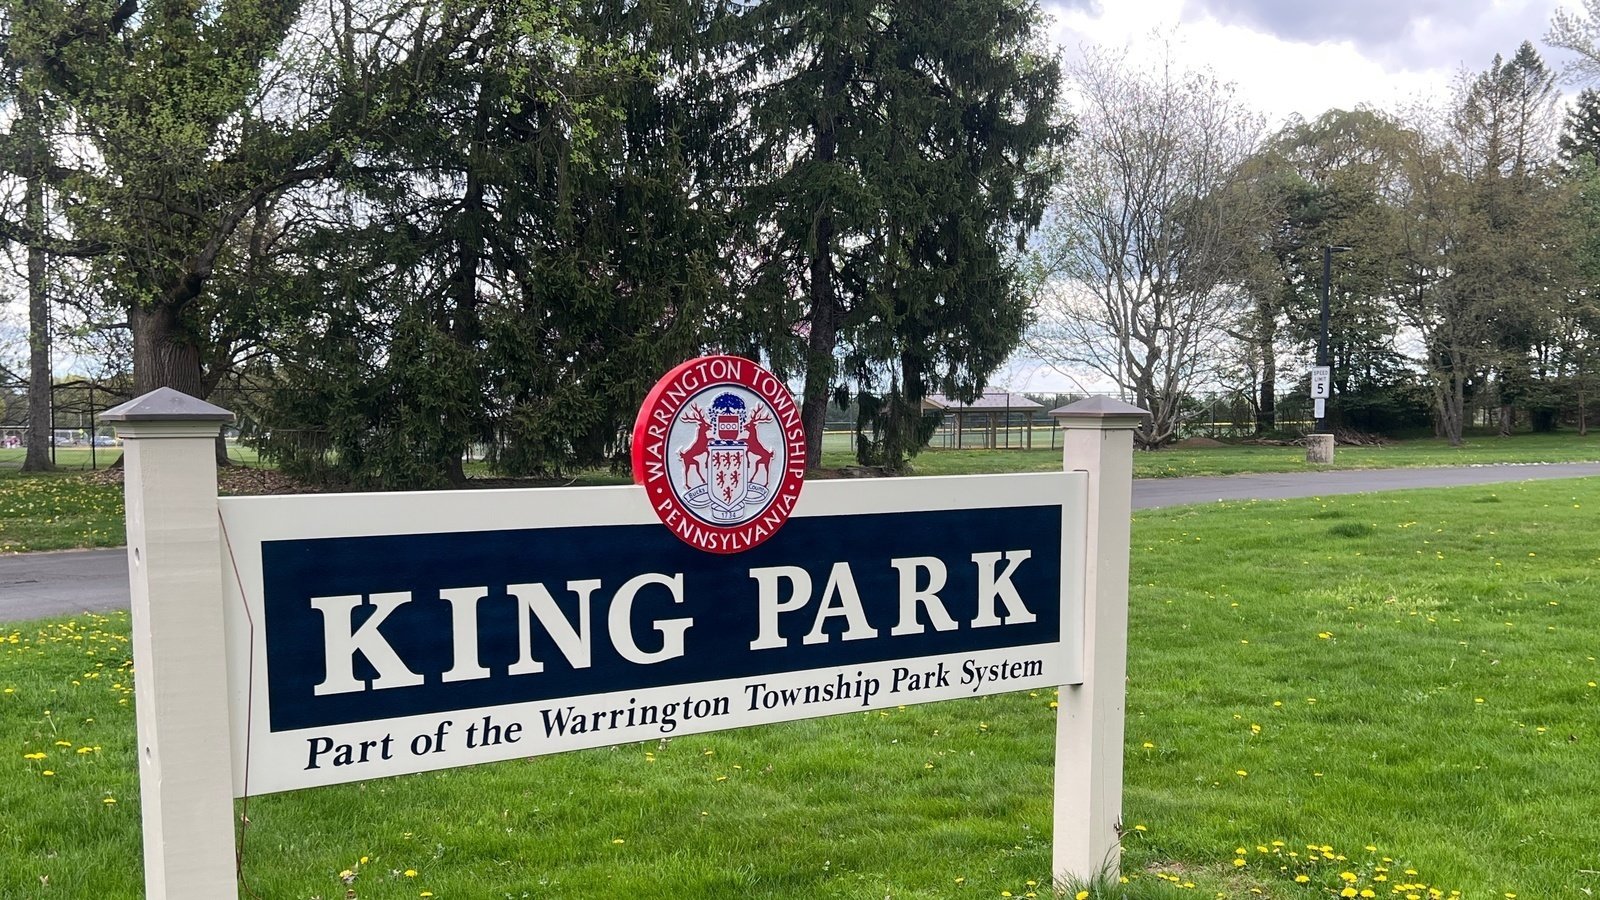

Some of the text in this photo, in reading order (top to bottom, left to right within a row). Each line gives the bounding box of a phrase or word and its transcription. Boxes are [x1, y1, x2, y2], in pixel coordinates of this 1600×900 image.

[645, 359, 805, 482] WARRINGTON TOWNSHIP
[1317, 383, 1324, 394] 5
[657, 493, 797, 550] PENNSYLVANIA
[688, 484, 768, 499] Bucks County
[310, 549, 1037, 697] KING PARK
[303, 659, 1043, 771] Part of the Warrington Township Park System
